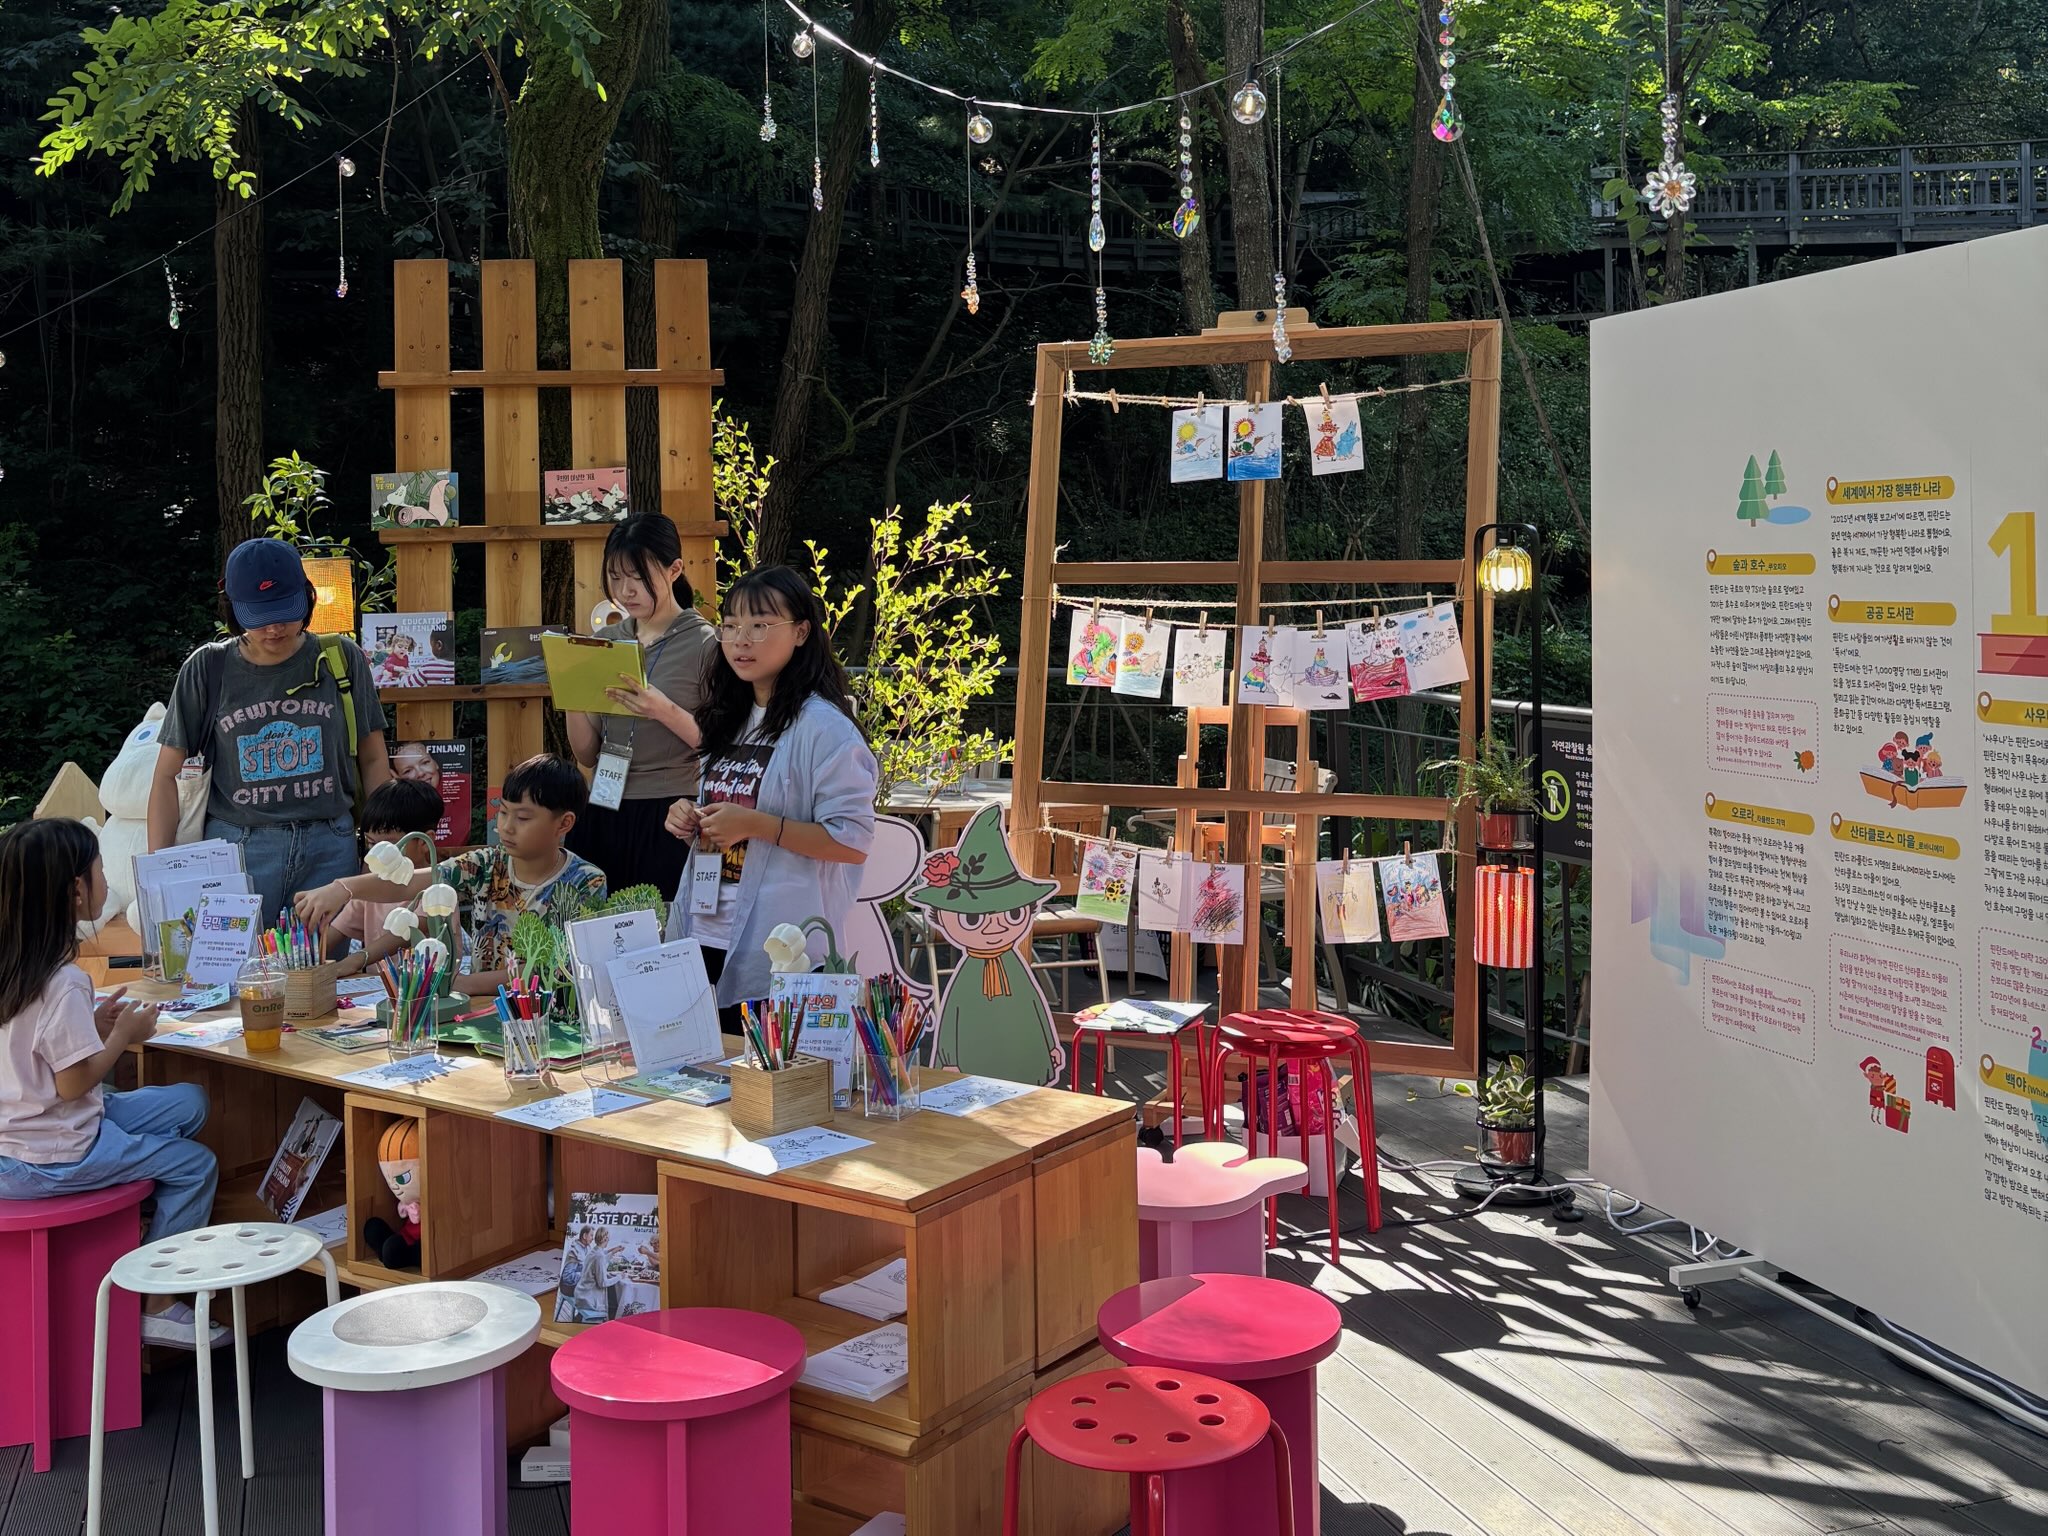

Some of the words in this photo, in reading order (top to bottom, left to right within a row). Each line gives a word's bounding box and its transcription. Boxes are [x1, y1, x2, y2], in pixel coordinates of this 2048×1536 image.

[1842, 486, 1875, 500] 세계에서
[1877, 484, 1893, 498] 가장
[1895, 483, 1921, 497] 행복한
[1923, 481, 1941, 495] 나라
[1867, 513, 1878, 523] 행복
[1927, 510, 1951, 521] 핀란드는
[1877, 531, 1888, 539] 가장
[1890, 530, 1906, 540] 행복한
[1908, 530, 1925, 538] 나라로
[1890, 547, 1902, 556] 자연
[1924, 545, 1949, 557] 사람들이
[1733, 559, 1747, 571] 숲과
[1832, 564, 1855, 574] 행복하게
[1875, 564, 1890, 573] 것으로
[1866, 606, 1884, 619] 공공
[1887, 607, 1914, 620] 도서관
[402, 617, 447, 625] EDUCATION
[1833, 632, 1849, 642] 핀란드
[1850, 633, 1873, 644] 사람들의
[1940, 637, 1952, 647] 것이
[1862, 664, 1873, 674] 인구
[1923, 669, 1948, 679] 도서관이
[1845, 679, 1862, 688] 정도로
[1864, 680, 1887, 690] 도서관이
[1910, 683, 1928, 694] 단순히
[1861, 695, 1876, 705] 공간이
[1896, 699, 1914, 709] 다양한
[1864, 711, 1883, 721] 다양한
[1884, 713, 1901, 724] 활동의
[2025, 708, 2048, 723] 사우
[264, 728, 293, 740] don't
[1834, 723, 1844, 732] 하고
[243, 738, 318, 773] STOP
[426, 745, 466, 754] FINLAND
[1983, 750, 2009, 763] 핀란드식
[2011, 752, 2023, 764] 증기
[599, 769, 623, 781] STAFF
[2012, 771, 2039, 784] 사우나는
[232, 784, 287, 805] CITY
[294, 776, 334, 799] LIFE
[2014, 787, 2027, 798] 난로
[2029, 790, 2043, 799] 위에
[1998, 803, 2017, 815] 데우는
[2019, 806, 2038, 818] 이유는
[1984, 818, 2010, 832] 사우나를
[2012, 821, 2025, 831] 하기
[1850, 825, 1894, 843] 산타클로스
[1984, 834, 2004, 845] 다발로
[1835, 851, 1849, 862] 핀란드
[1984, 850, 1996, 862] 몸을
[1998, 854, 2019, 865] 때리는
[2020, 857, 2041, 871] 안마를
[696, 871, 718, 882] STAFF
[1834, 866, 1862, 879] 산타클로스
[1864, 873, 1881, 883] 마을이
[1984, 868, 2004, 879] 그렇게
[1984, 884, 2004, 897] 차가운
[2006, 887, 2026, 900] 호수에
[1852, 886, 1885, 900] 크리스마스인
[1894, 895, 1918, 907] 마을에는
[1919, 899, 1956, 917] 산타클로스를
[1879, 906, 1908, 920] 산타클로스
[1993, 901, 2013, 914] 호수에
[2015, 906, 2034, 921] 구멍을
[202, 916, 250, 933] 무민컬러링
[614, 919, 634, 930] MOOMIN
[1879, 920, 1906, 935] 산타클로스
[807, 1012, 849, 1029] 그리기
[2006, 1073, 2026, 1092] 백야
[1985, 1097, 2004, 1110] 핀란드
[2021, 1109, 2028, 1120] 약
[1985, 1116, 2004, 1130] 그래서
[2006, 1124, 2033, 1141] 여름에는
[1985, 1133, 1999, 1144] 백야
[2000, 1138, 2021, 1152] 현상이
[1985, 1153, 2003, 1166] 시간이
[2009, 1178, 2029, 1194] 밤으로
[573, 1213, 581, 1224] A
[585, 1214, 619, 1225] TASTE
[622, 1214, 638, 1225] OF
